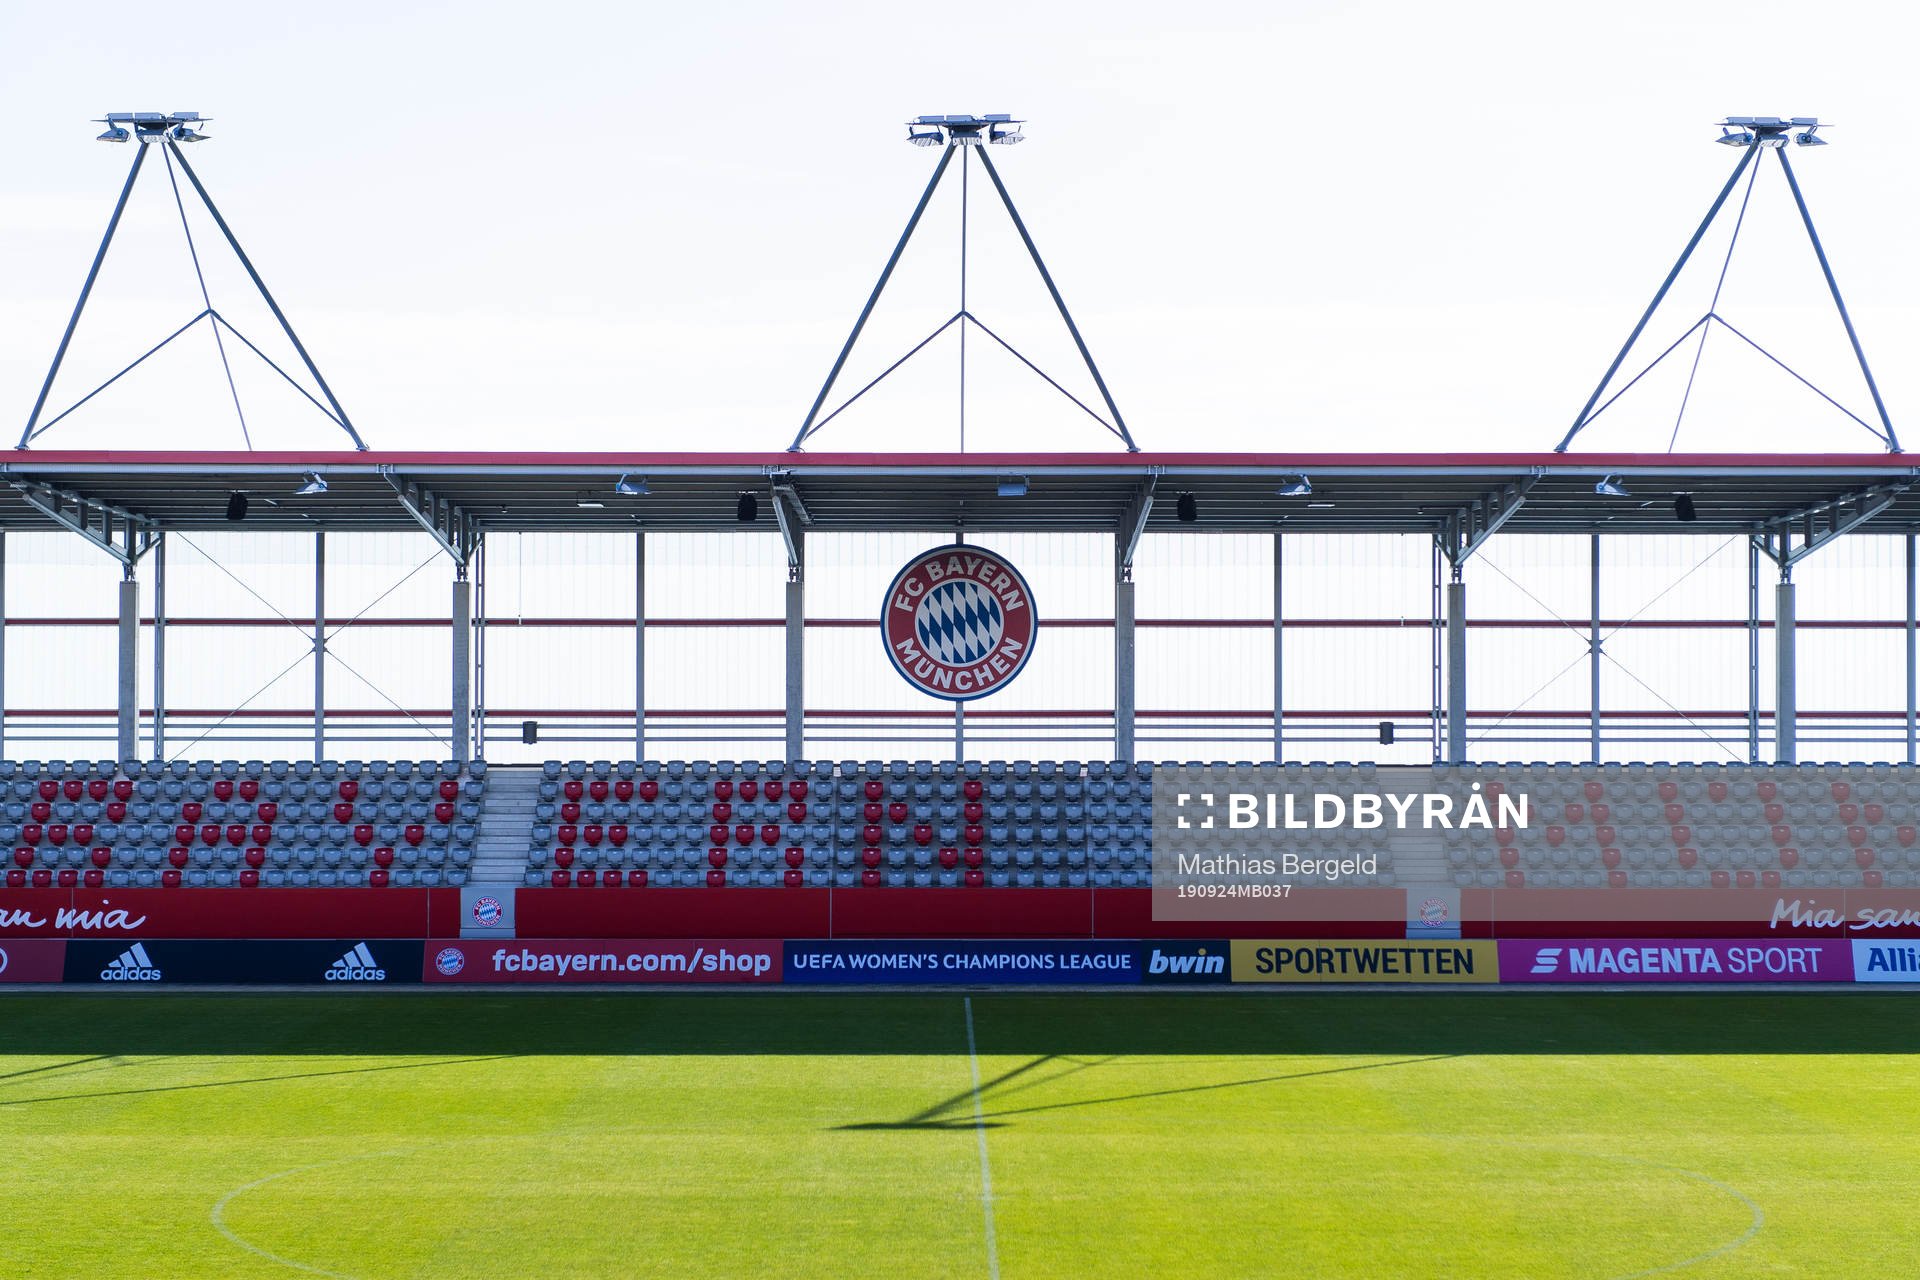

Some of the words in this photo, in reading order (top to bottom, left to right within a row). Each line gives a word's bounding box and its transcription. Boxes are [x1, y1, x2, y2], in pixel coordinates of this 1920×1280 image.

[894, 577, 924, 613] FC
[925, 556, 1025, 611] BAYERN
[896, 637, 1023, 690] MÜNCHEN
[55, 899, 146, 929] mia
[1770, 898, 1845, 929] Mia
[492, 948, 771, 976] fcbayern.com/shop
[793, 954, 845, 969] UEFA
[849, 954, 938, 969] WOMEN'S
[943, 954, 1055, 969] CHAMPIONS
[1060, 954, 1131, 969] LEAGUE
[1149, 949, 1224, 974] bwin
[1255, 947, 1474, 974] SPORTWETTEN
[1570, 948, 1722, 973] MAGENTA
[1727, 947, 1822, 973] SPORT
[1867, 947, 1920, 972] Alli
[101, 966, 161, 981] adidas
[325, 966, 386, 981] adidas
